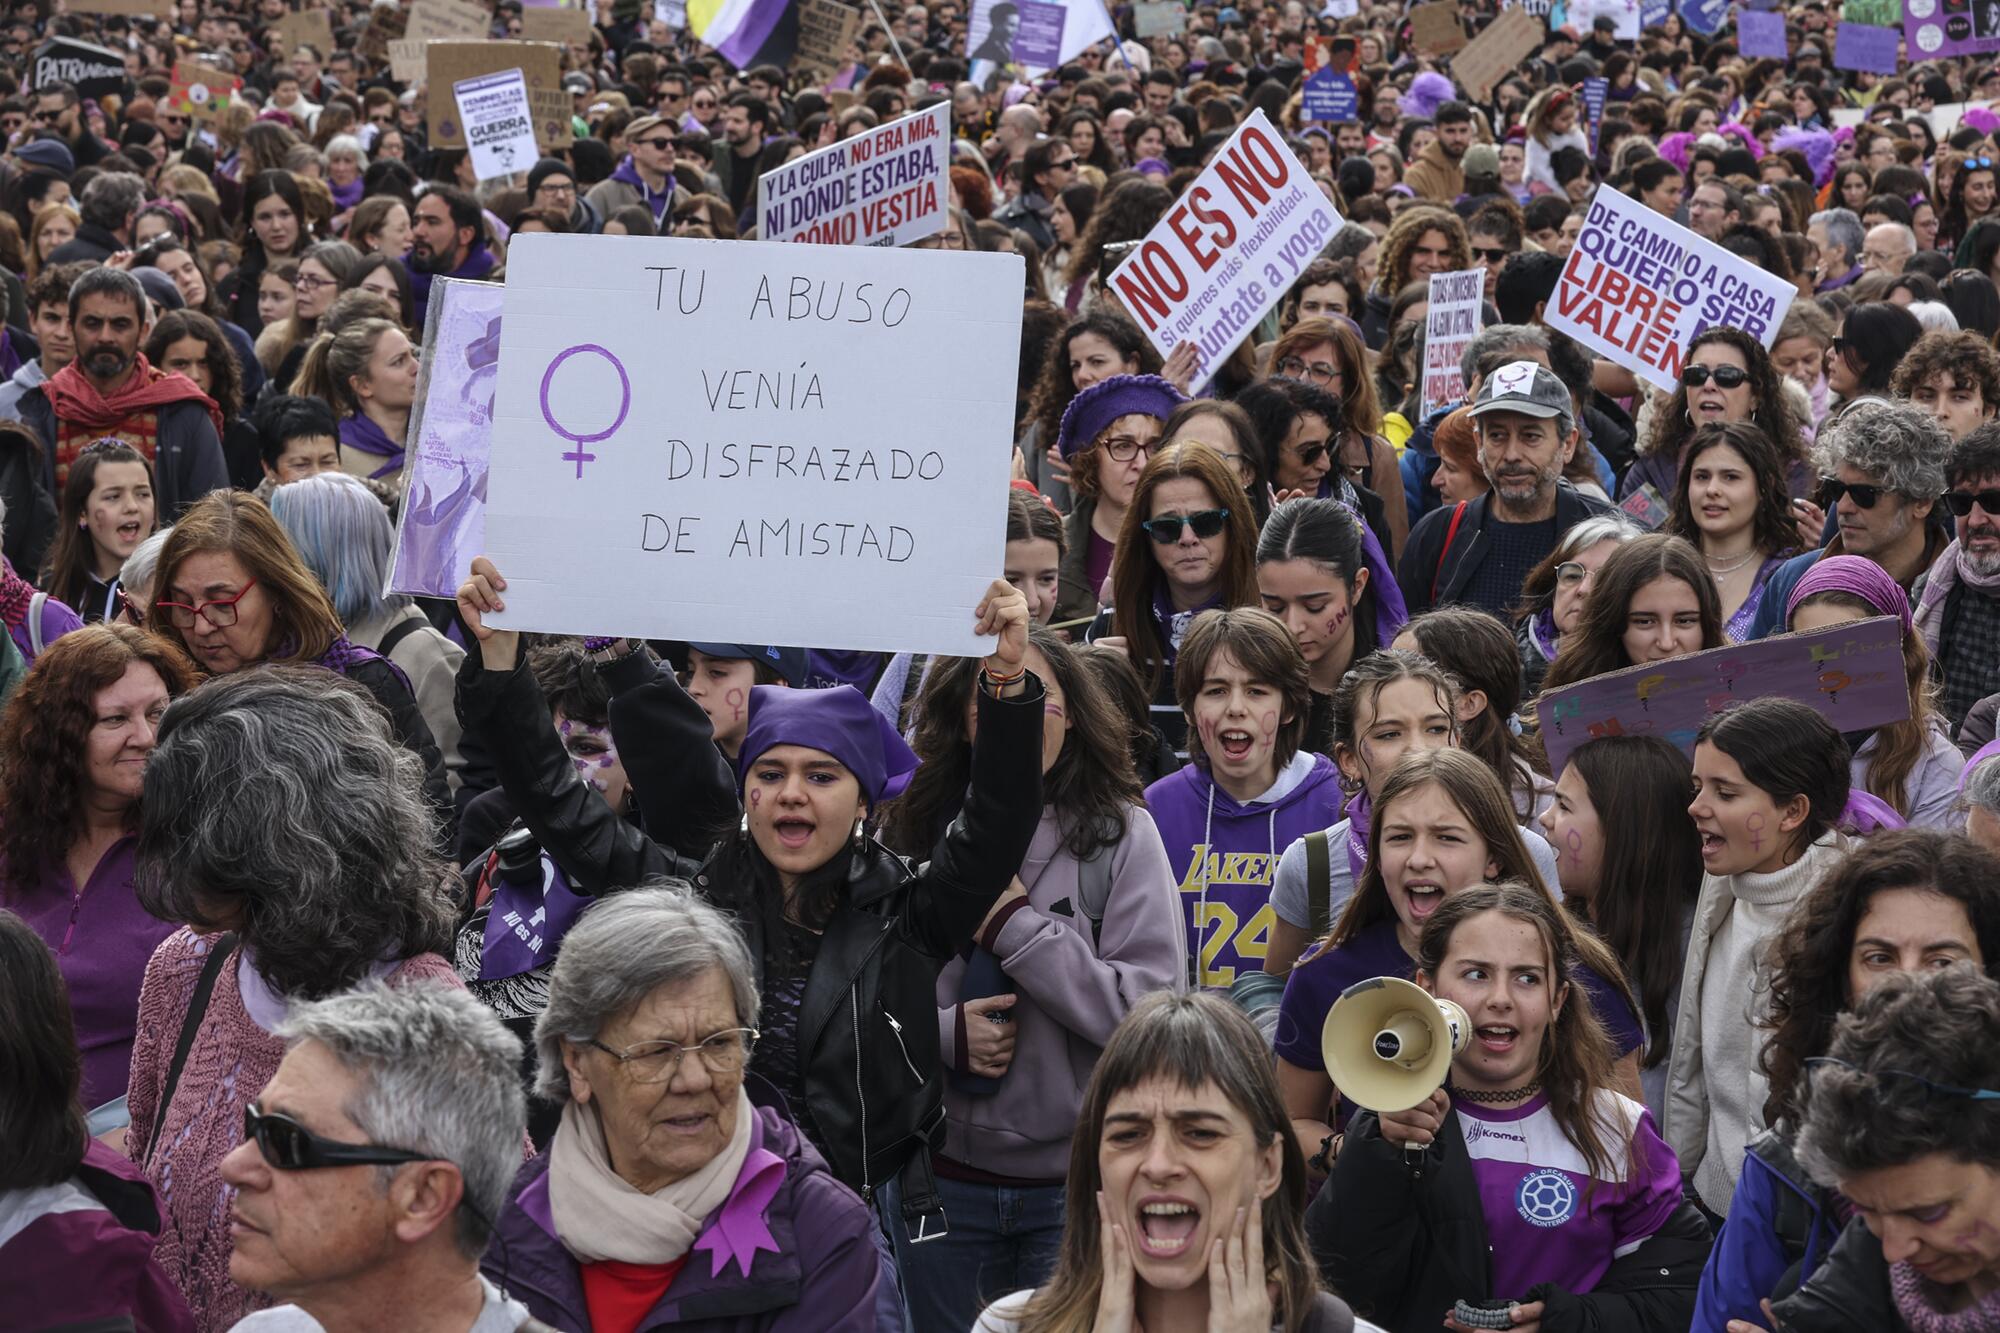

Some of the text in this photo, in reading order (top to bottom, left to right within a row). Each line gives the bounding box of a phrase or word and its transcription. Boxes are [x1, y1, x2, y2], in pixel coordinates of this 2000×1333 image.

[470, 116, 527, 138] GUERRA
[766, 113, 940, 201] Y LA CULPA NO ERA MÍA,
[766, 145, 939, 240] NI DÓNDE ESTABA,
[861, 178, 938, 238] VESTÍA
[1115, 127, 1289, 332] NO ES NO
[1160, 185, 1308, 348] Si quieres más flexibilidad,
[1431, 278, 1447, 304] TODAS
[1580, 228, 1699, 306] QUIERO
[1588, 202, 1776, 321] DE CAMINO A CASA
[644, 265, 911, 328] TU ABUSO
[1192, 208, 1332, 381] púntate a yoga
[1563, 250, 1681, 347] LIBRE,
[1558, 281, 1689, 381] VALIEN
[701, 361, 825, 412] VENÍA
[668, 439, 945, 482] DISFRAZADO
[641, 513, 915, 563] DE AMISTAD
[1178, 843, 1282, 893] LAKER
[502, 911, 522, 927] NO
[514, 923, 530, 942] es
[1193, 901, 1277, 988] 24
[1482, 1128, 1526, 1143] Kromex
[1540, 1168, 1576, 1190] ORCASUR
[1517, 1206, 1570, 1228] SIN FRONTERAS
